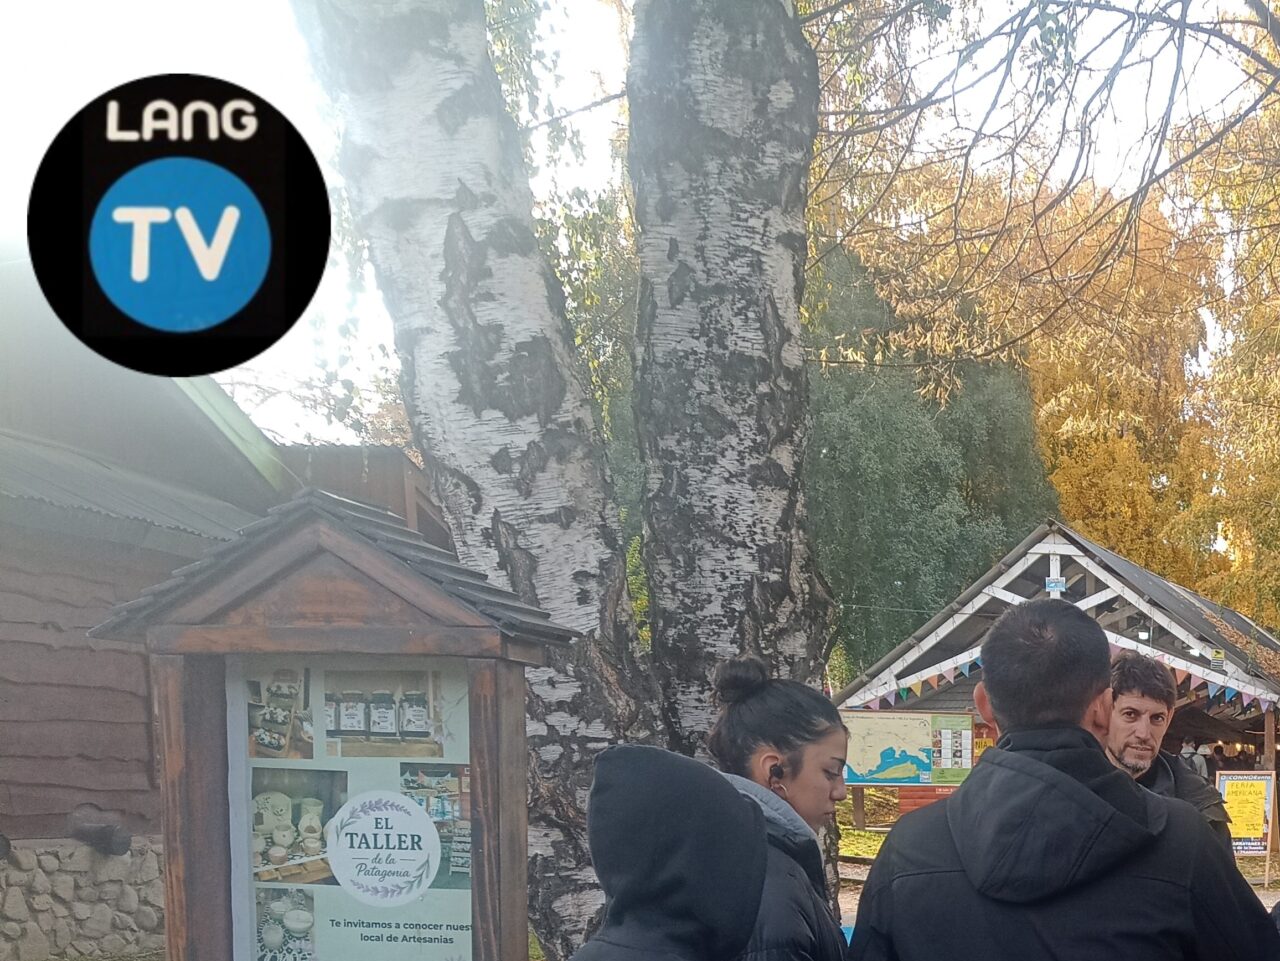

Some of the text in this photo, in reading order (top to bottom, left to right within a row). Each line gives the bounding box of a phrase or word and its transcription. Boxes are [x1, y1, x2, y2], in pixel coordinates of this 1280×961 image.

[374, 817, 393, 830] EL
[345, 832, 423, 851] TALLER
[371, 853, 397, 865] de la
[355, 863, 411, 882] Patagonia
[329, 919, 341, 928] Te
[343, 919, 392, 929] invitamos
[403, 922, 444, 931] conocer
[360, 933, 454, 944] local de Artesanias
